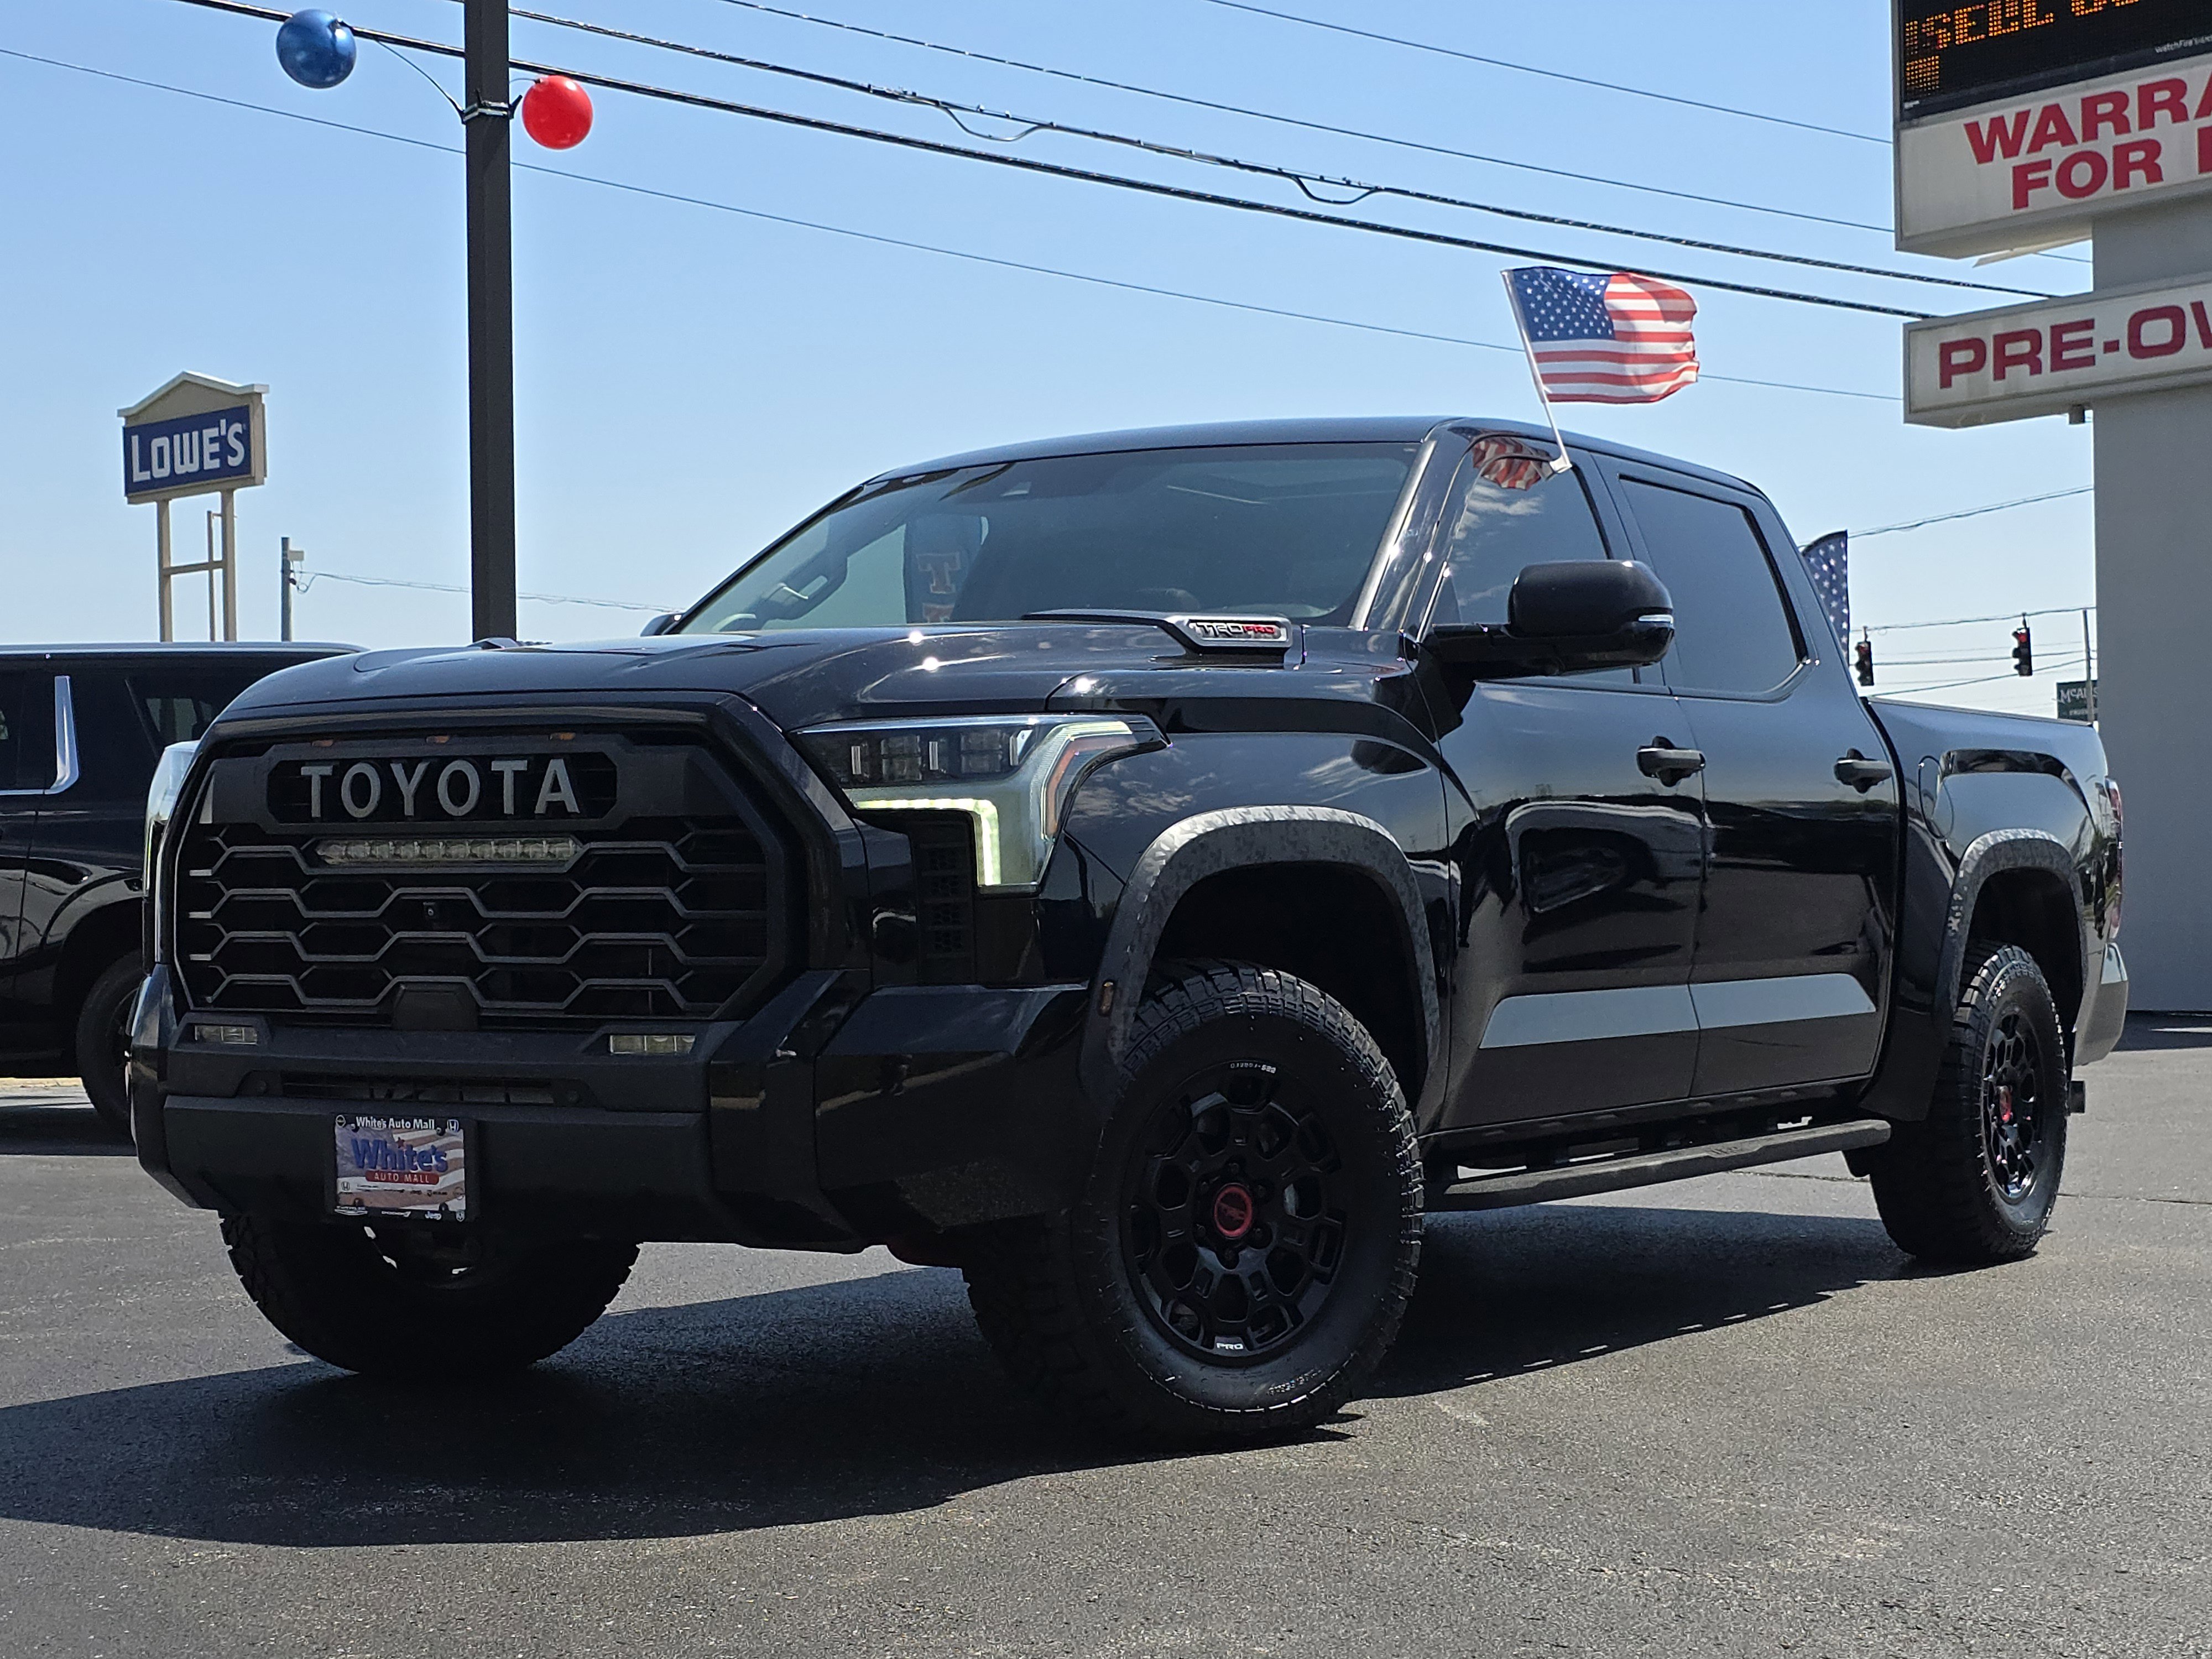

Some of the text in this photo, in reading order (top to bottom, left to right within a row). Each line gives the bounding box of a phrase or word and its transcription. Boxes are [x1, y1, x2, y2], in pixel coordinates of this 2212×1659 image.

[2012, 139, 2163, 210] FOR
[131, 419, 245, 482] LOWE'S
[301, 758, 580, 818] TOYOTA
[356, 1116, 435, 1130] White's Auto Mall
[351, 1138, 448, 1172] White's
[374, 1172, 429, 1183] AUTO MALL
